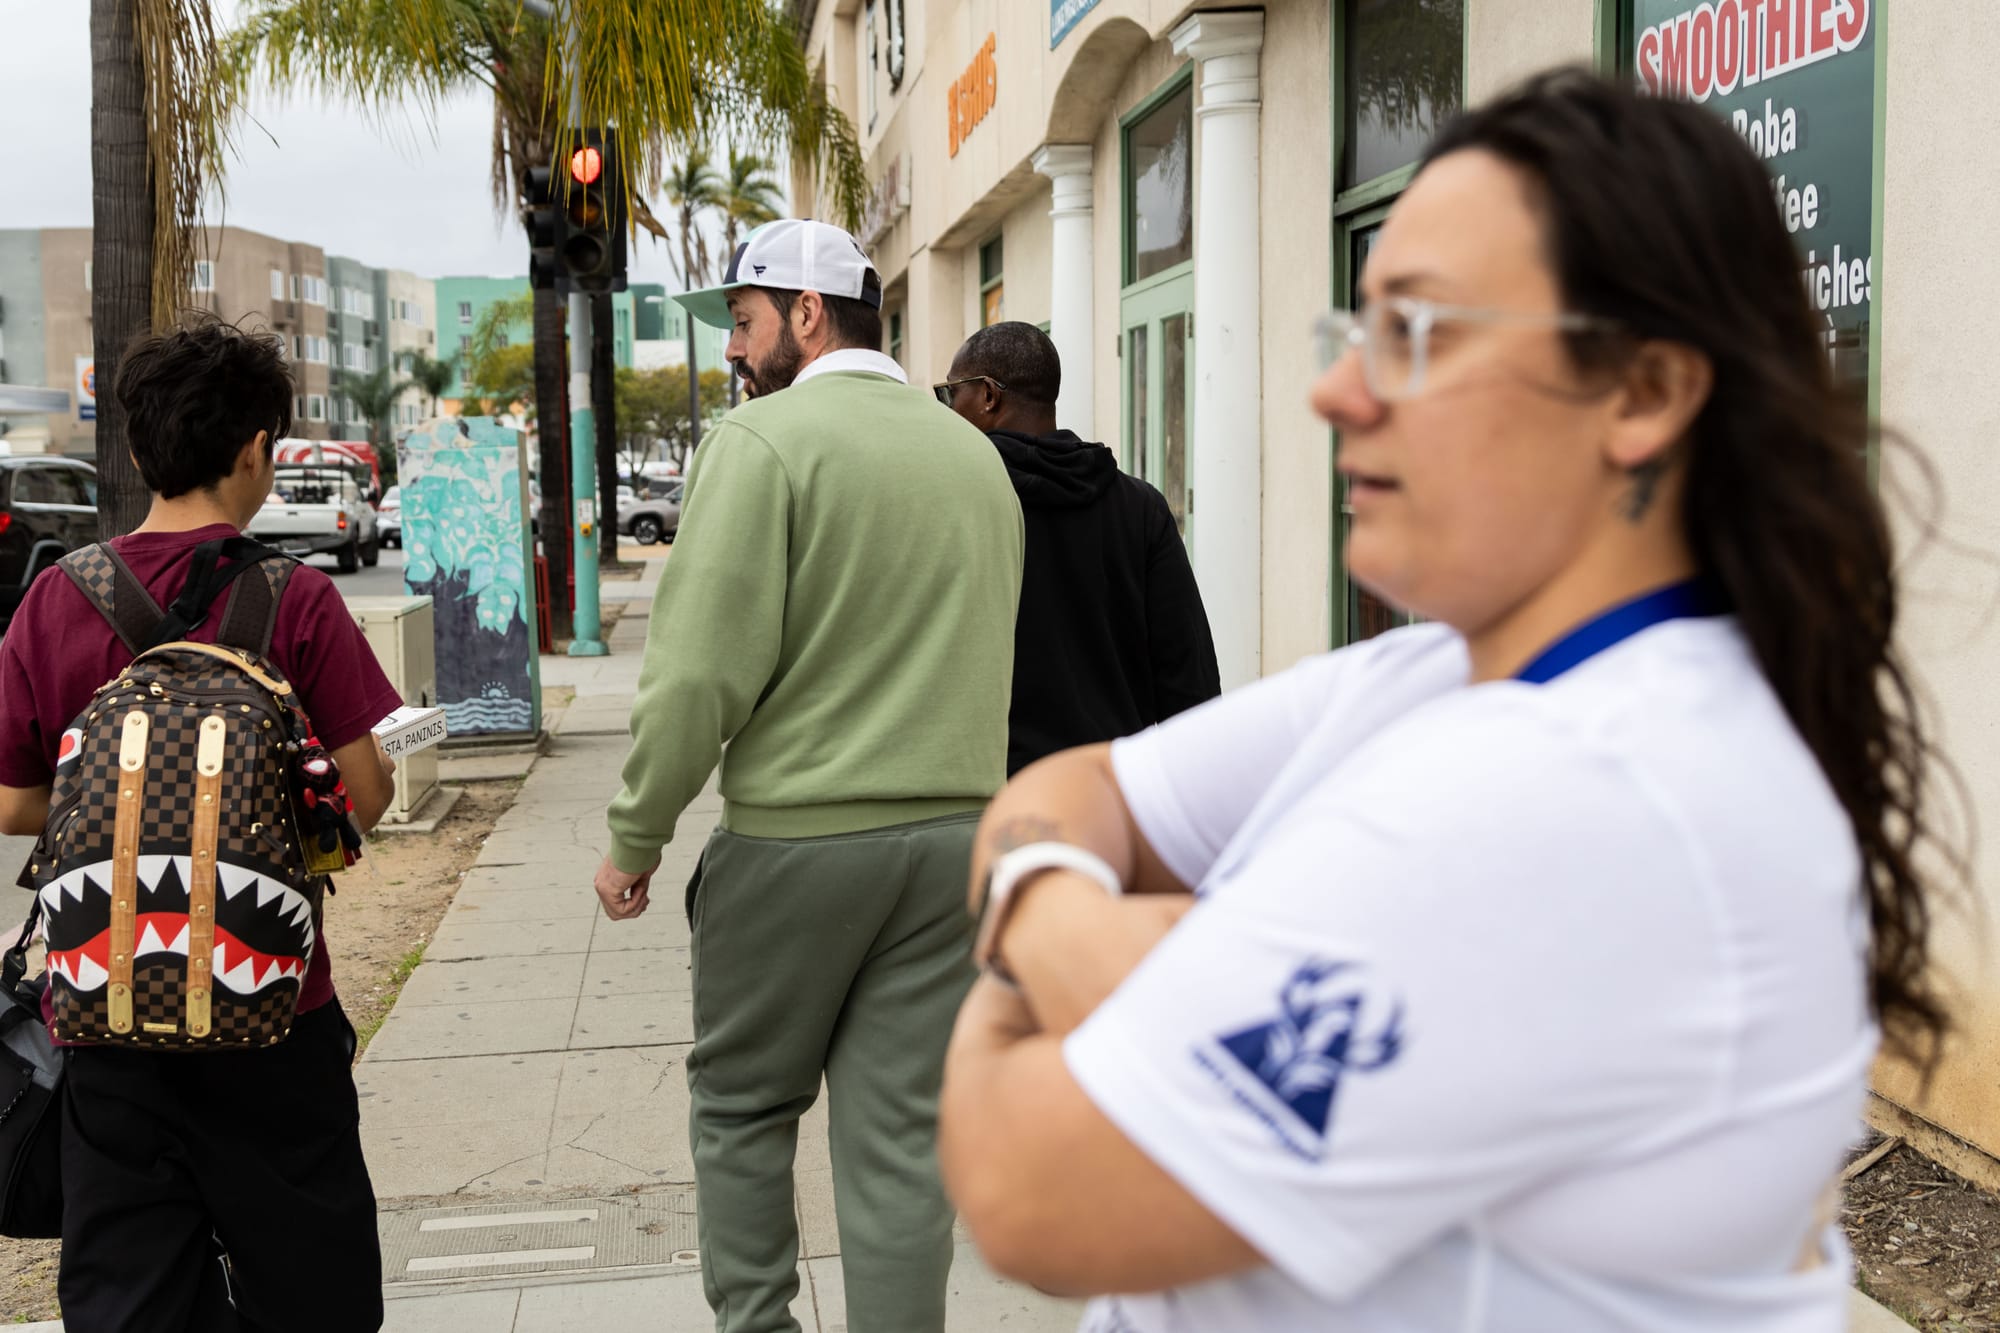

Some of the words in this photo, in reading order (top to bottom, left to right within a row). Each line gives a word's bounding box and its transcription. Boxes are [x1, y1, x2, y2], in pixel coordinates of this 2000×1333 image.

[1636, 0, 1869, 102] SMOOTHIES
[1733, 98, 1797, 160] Boba
[1769, 174, 1818, 234] fee
[381, 739, 404, 757] STA.
[405, 720, 445, 749] PANINIS.
